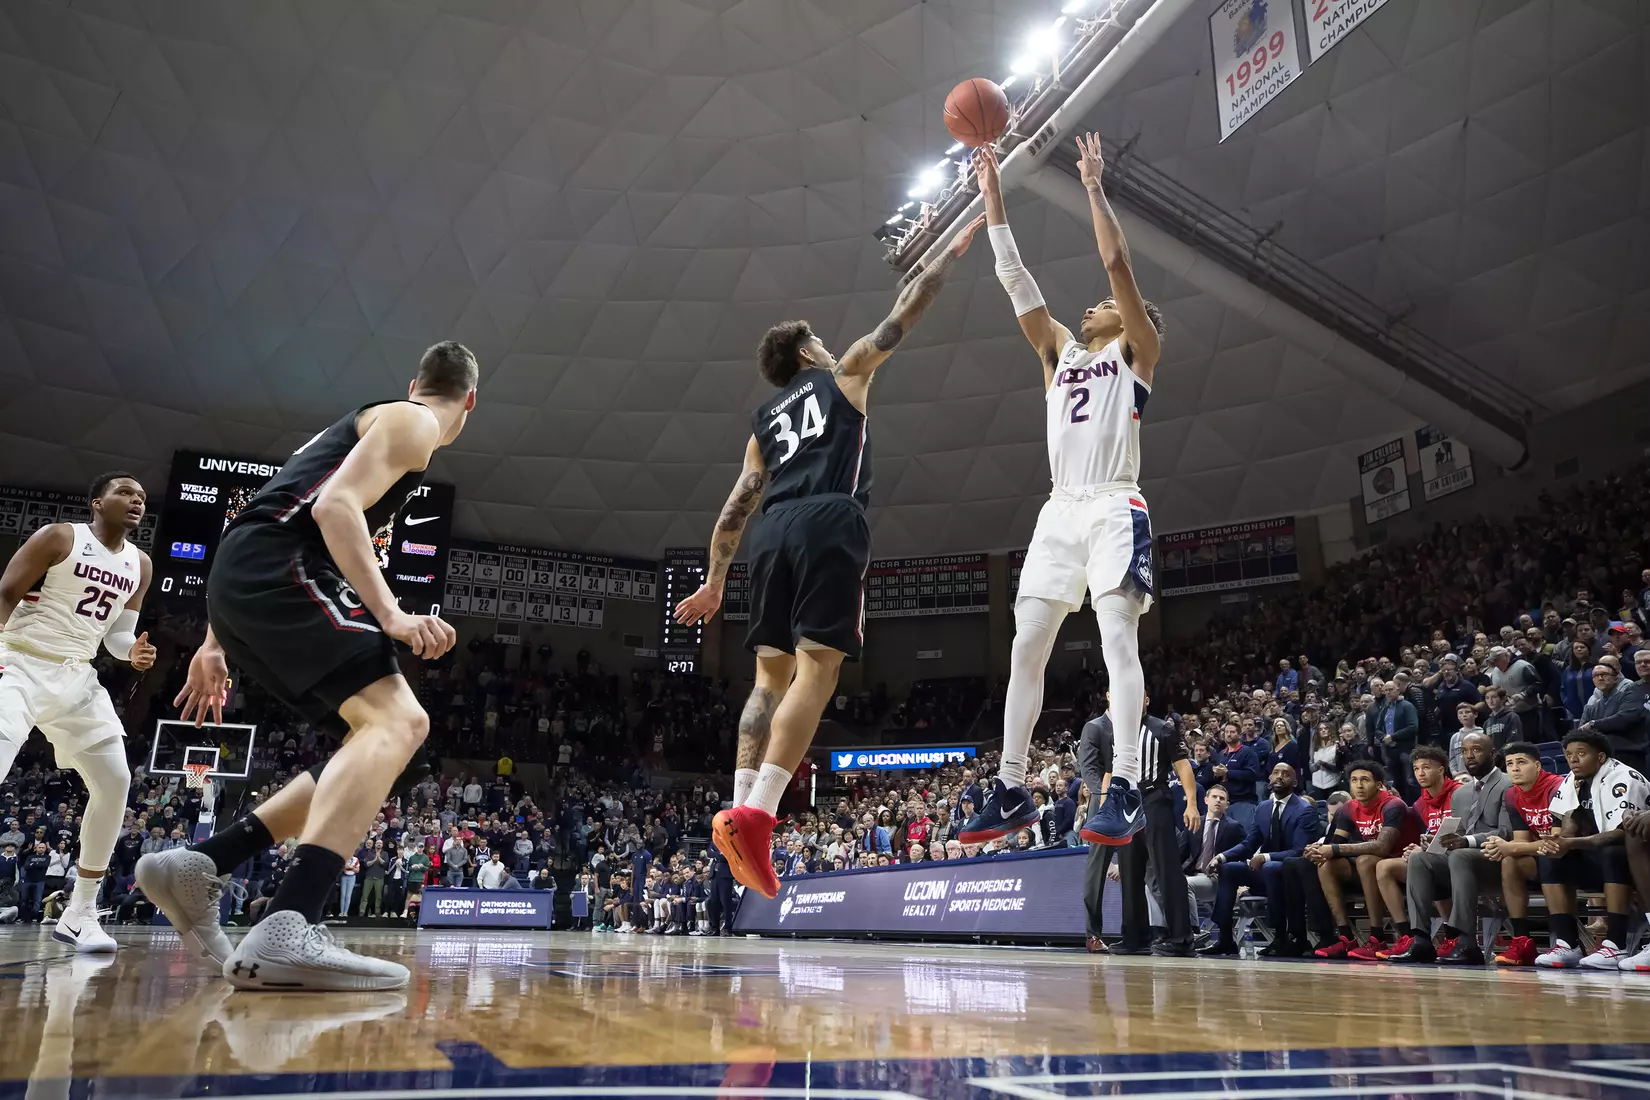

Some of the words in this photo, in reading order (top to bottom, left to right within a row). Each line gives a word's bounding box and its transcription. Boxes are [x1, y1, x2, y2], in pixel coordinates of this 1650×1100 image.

[1323, 0, 1360, 31] NATIO
[1320, 0, 1380, 50] CHAMPIO
[1226, 31, 1285, 97] 1999
[1232, 61, 1285, 111] NATIONAL
[1228, 70, 1291, 129] CHAMPIONS
[770, 381, 814, 416] CUMBERLAND
[1070, 387, 1090, 424] 2
[769, 393, 827, 465] 34
[199, 457, 284, 477] UNIVERSIT
[0, 487, 43, 498] USKIES
[181, 483, 219, 496] WELLS
[180, 492, 217, 504] FARGO
[1165, 532, 1195, 543] NCAA
[1200, 519, 1286, 538] CHAMPIONSHIP
[171, 542, 203, 554] CBS
[411, 548, 436, 557] DONUTS
[498, 545, 527, 553] UCONN
[531, 549, 568, 558] HUSKIES
[586, 556, 614, 564] HONOR
[873, 560, 900, 569] NCAA
[904, 555, 981, 567] CHAMPIONSHIP
[451, 563, 470, 576] 52
[73, 562, 134, 594] UCONN
[161, 577, 174, 592] 0
[396, 574, 428, 583] TRAVELERS
[534, 572, 549, 584] 13
[559, 575, 577, 588] 42
[588, 578, 599, 590] 34
[614, 581, 624, 592] 32
[639, 584, 650, 595] 50
[1164, 584, 1217, 595] CONNECTICUT
[75, 586, 119, 621] 25
[452, 596, 461, 608] 15
[478, 599, 490, 611] 22
[532, 605, 544, 617] 42
[560, 608, 570, 619] 13
[588, 610, 594, 621] 3
[904, 880, 949, 901] UCONN
[955, 879, 1012, 895] ORTHOPEDICS
[1014, 878, 1022, 891] &
[436, 900, 474, 909] UCONN
[795, 893, 811, 905] TEAM
[903, 904, 936, 917] HEALTH
[949, 898, 981, 913] SPORTS
[983, 897, 1026, 912] MEDICINE
